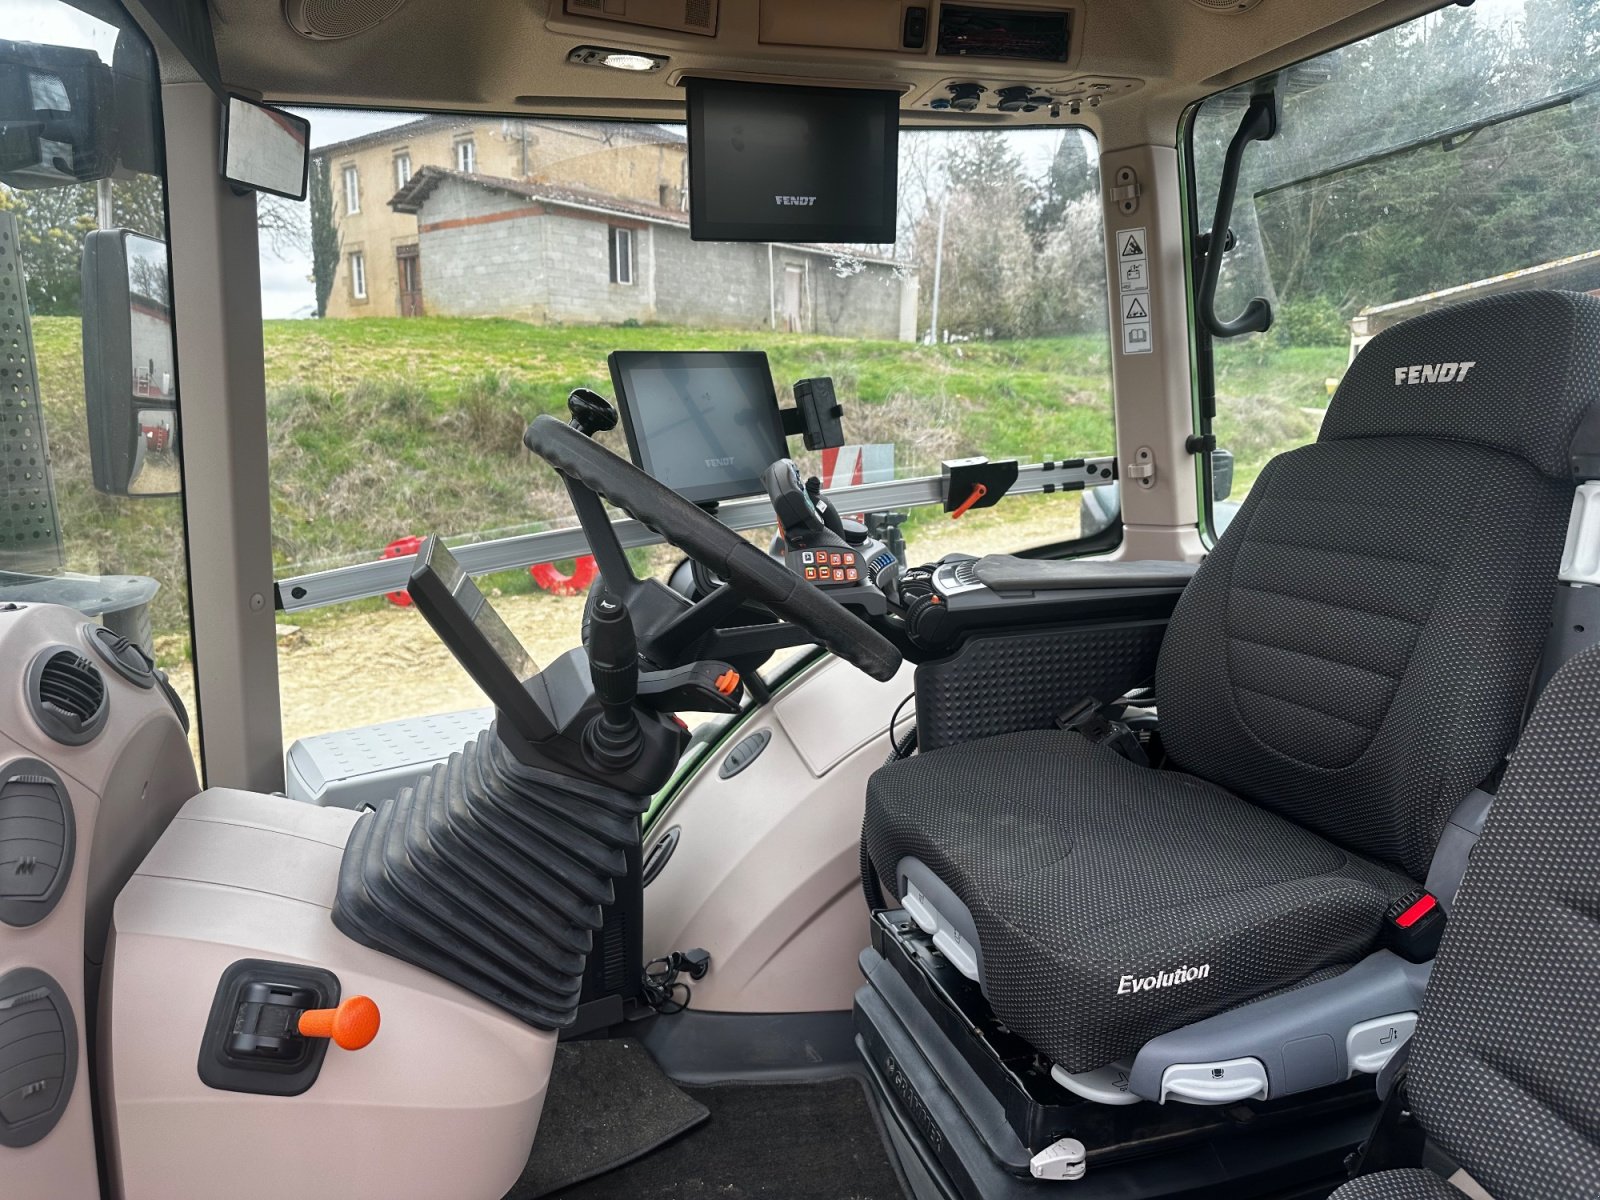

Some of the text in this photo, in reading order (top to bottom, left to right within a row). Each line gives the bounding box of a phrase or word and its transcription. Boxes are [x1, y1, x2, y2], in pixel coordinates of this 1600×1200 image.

[775, 195, 817, 206] FENDT
[1394, 361, 1476, 386] FENDT
[704, 456, 735, 468] FENDT
[1116, 963, 1210, 995] Evolution
